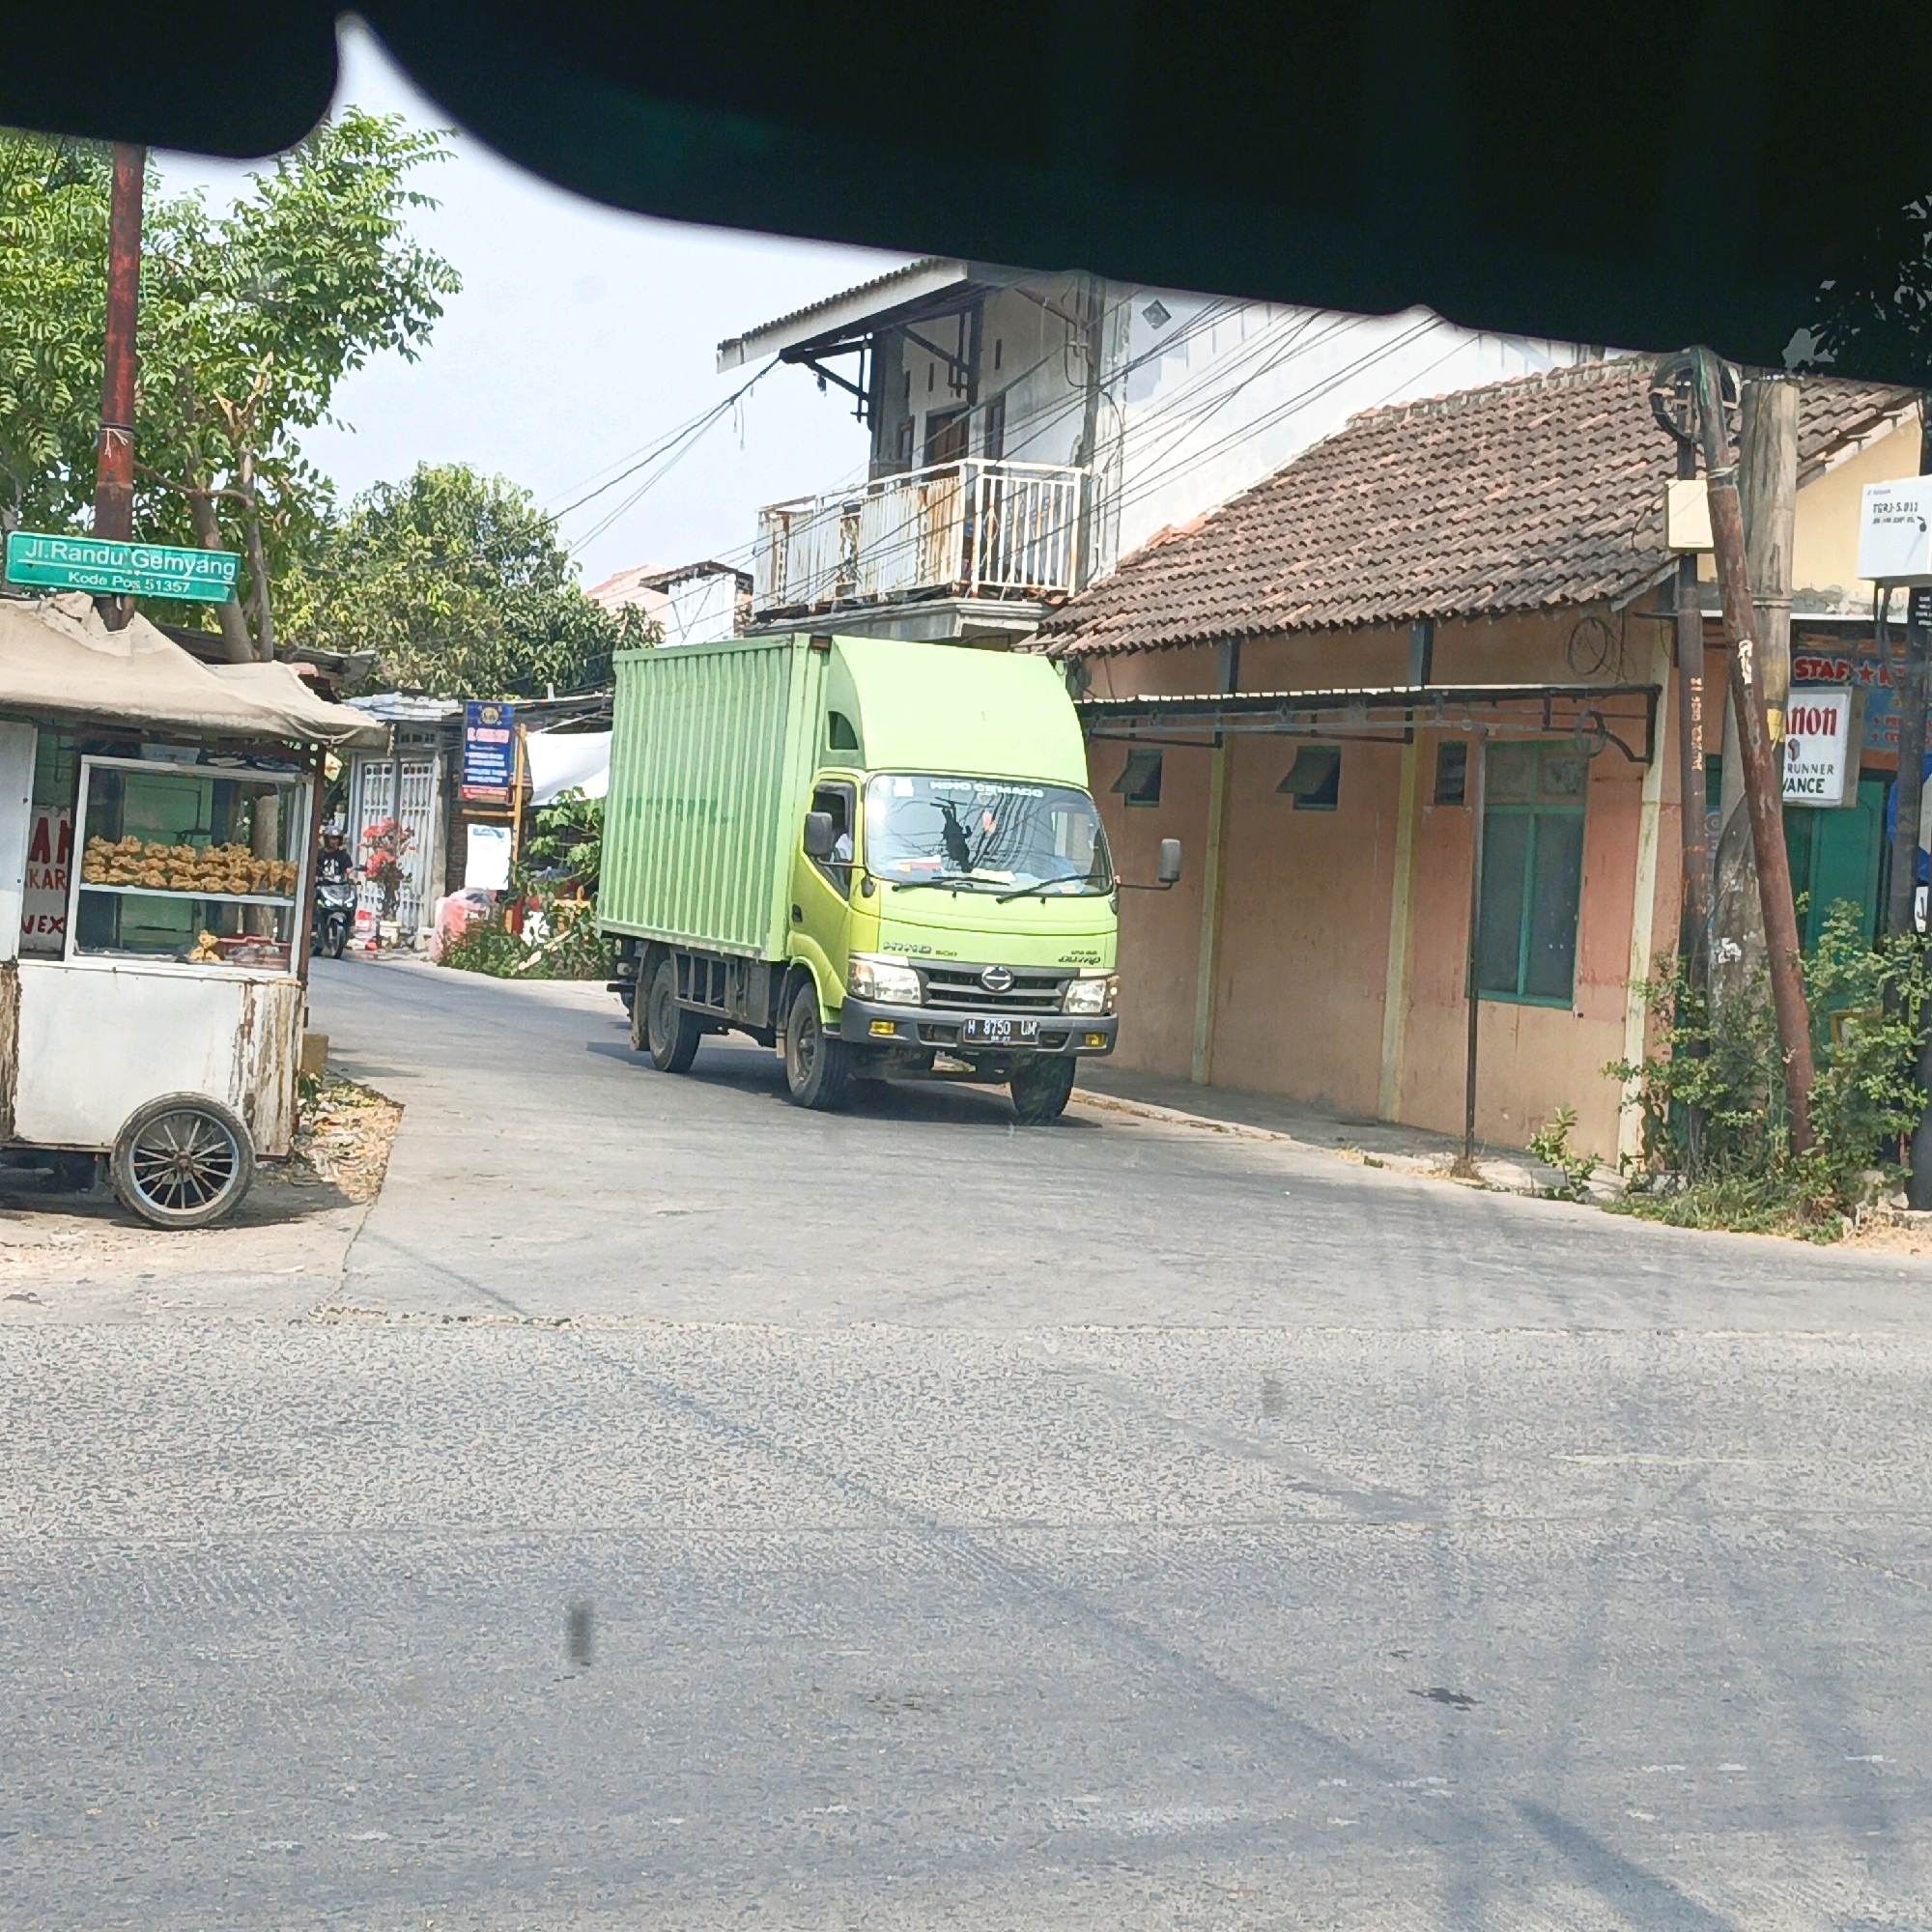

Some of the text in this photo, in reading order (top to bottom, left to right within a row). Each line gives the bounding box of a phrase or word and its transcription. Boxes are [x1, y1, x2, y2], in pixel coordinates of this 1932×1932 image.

[25, 539, 237, 582] Jl.Randu Gemyang
[68, 571, 190, 593] Kode Pos 51357
[1785, 706, 1837, 736] non
[967, 1019, 976, 1036] H
